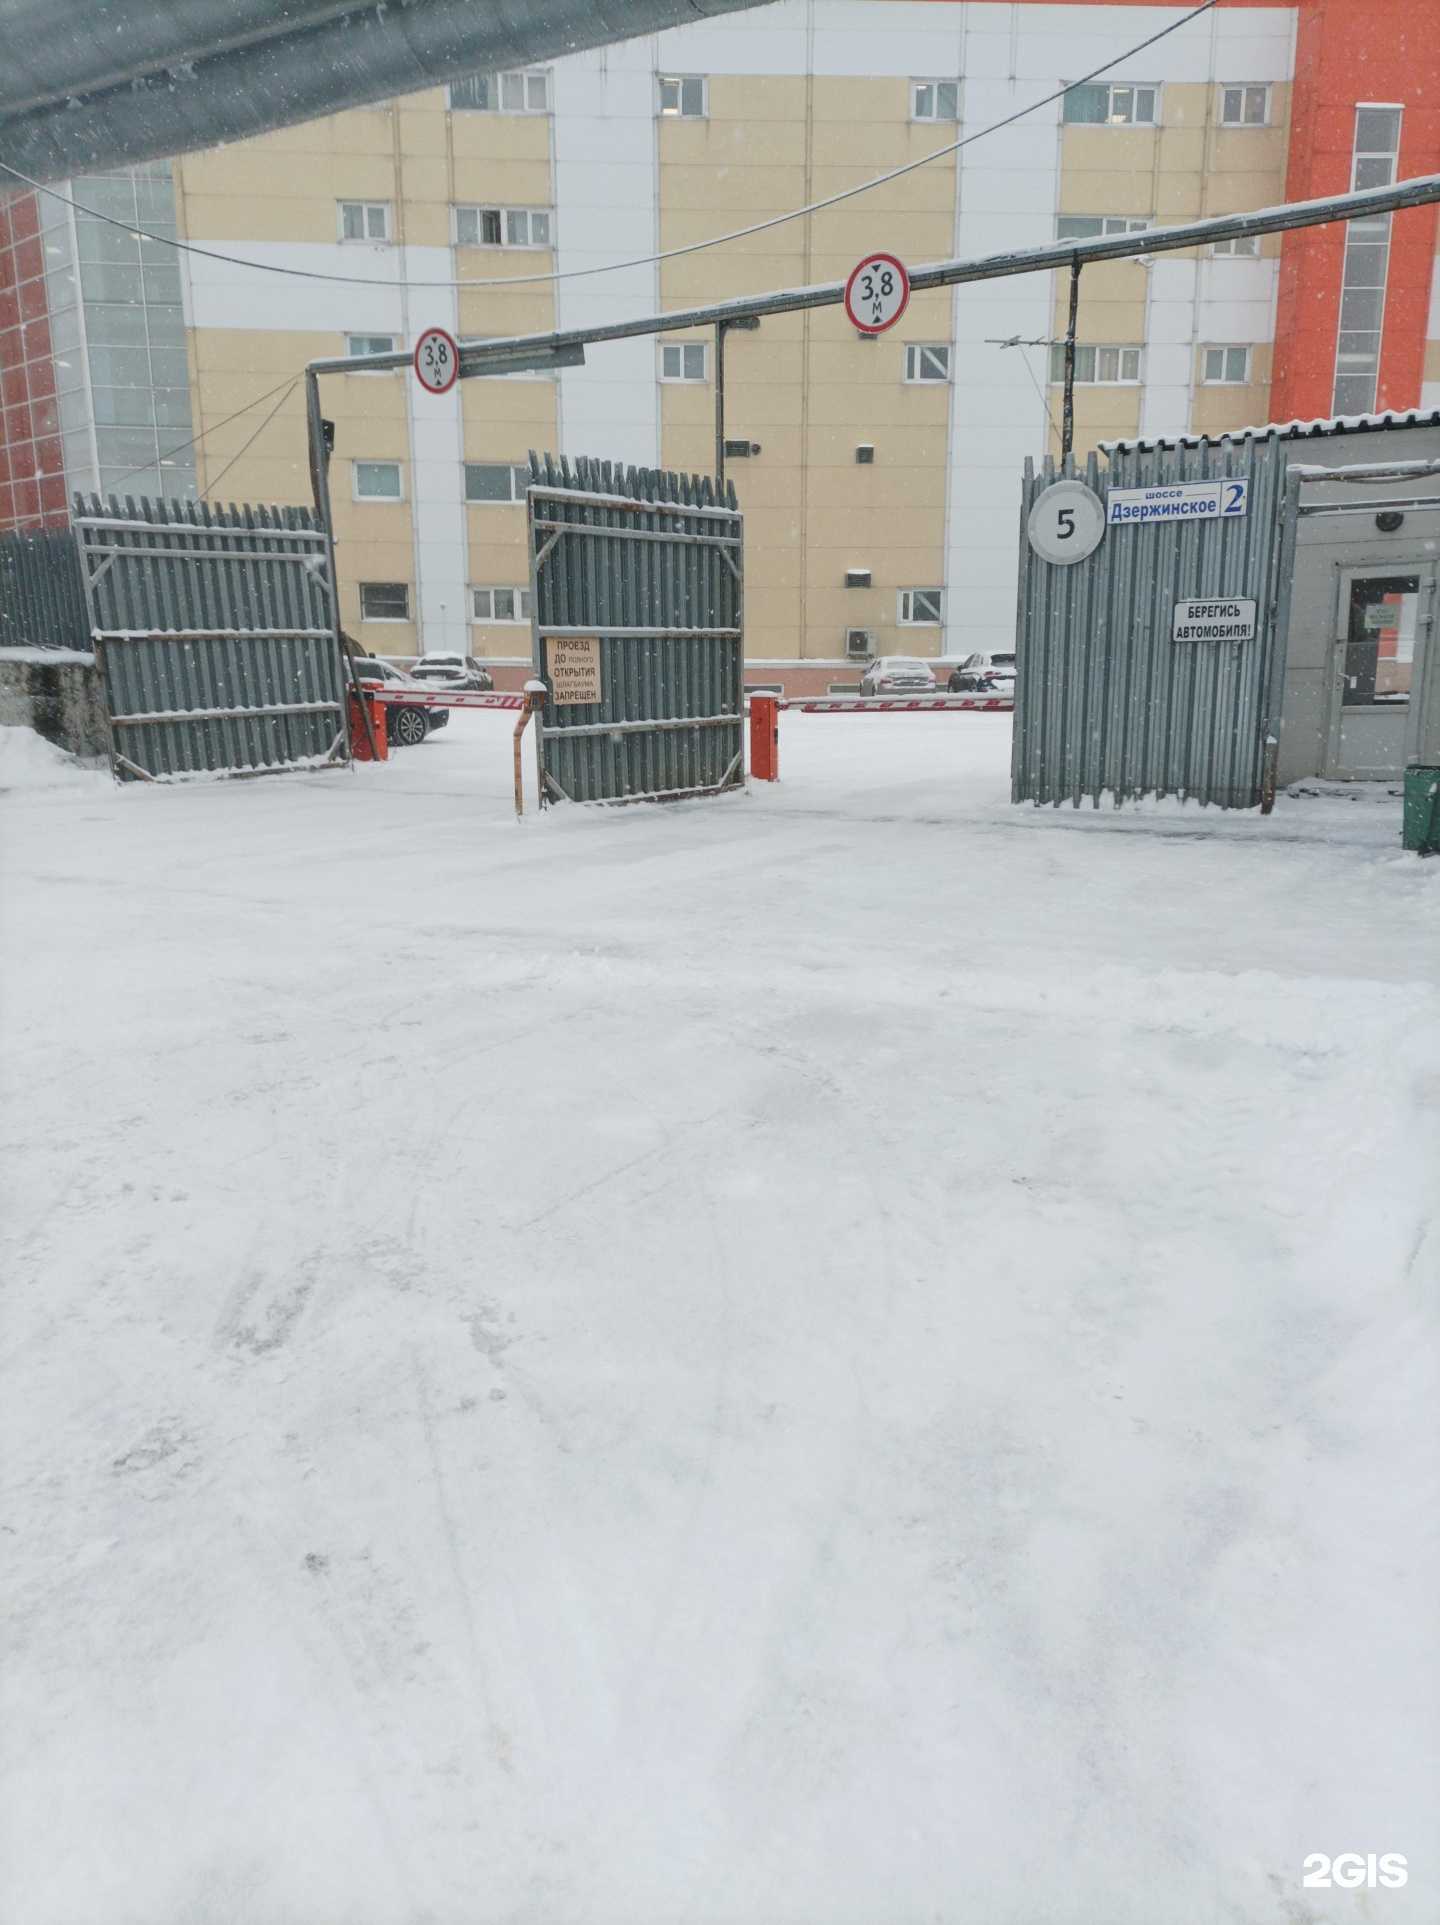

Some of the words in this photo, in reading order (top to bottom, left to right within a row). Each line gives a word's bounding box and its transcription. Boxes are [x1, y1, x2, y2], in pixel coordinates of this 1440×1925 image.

[861, 271, 894, 301] 3,8
[425, 344, 447, 367] 3,8
[1145, 490, 1183, 500] шоссе
[1224, 484, 1245, 513] 2
[1111, 499, 1217, 522] Дзержинское
[1056, 508, 1075, 539] 5
[1187, 604, 1241, 619] БЕРЕГИСЬ
[1176, 624, 1251, 639] АВТОМОБИЛЯ!
[557, 641, 590, 652] ПРОЕЗД
[554, 654, 566, 664] ДО
[554, 667, 596, 677] ОТКРЫТИЯ
